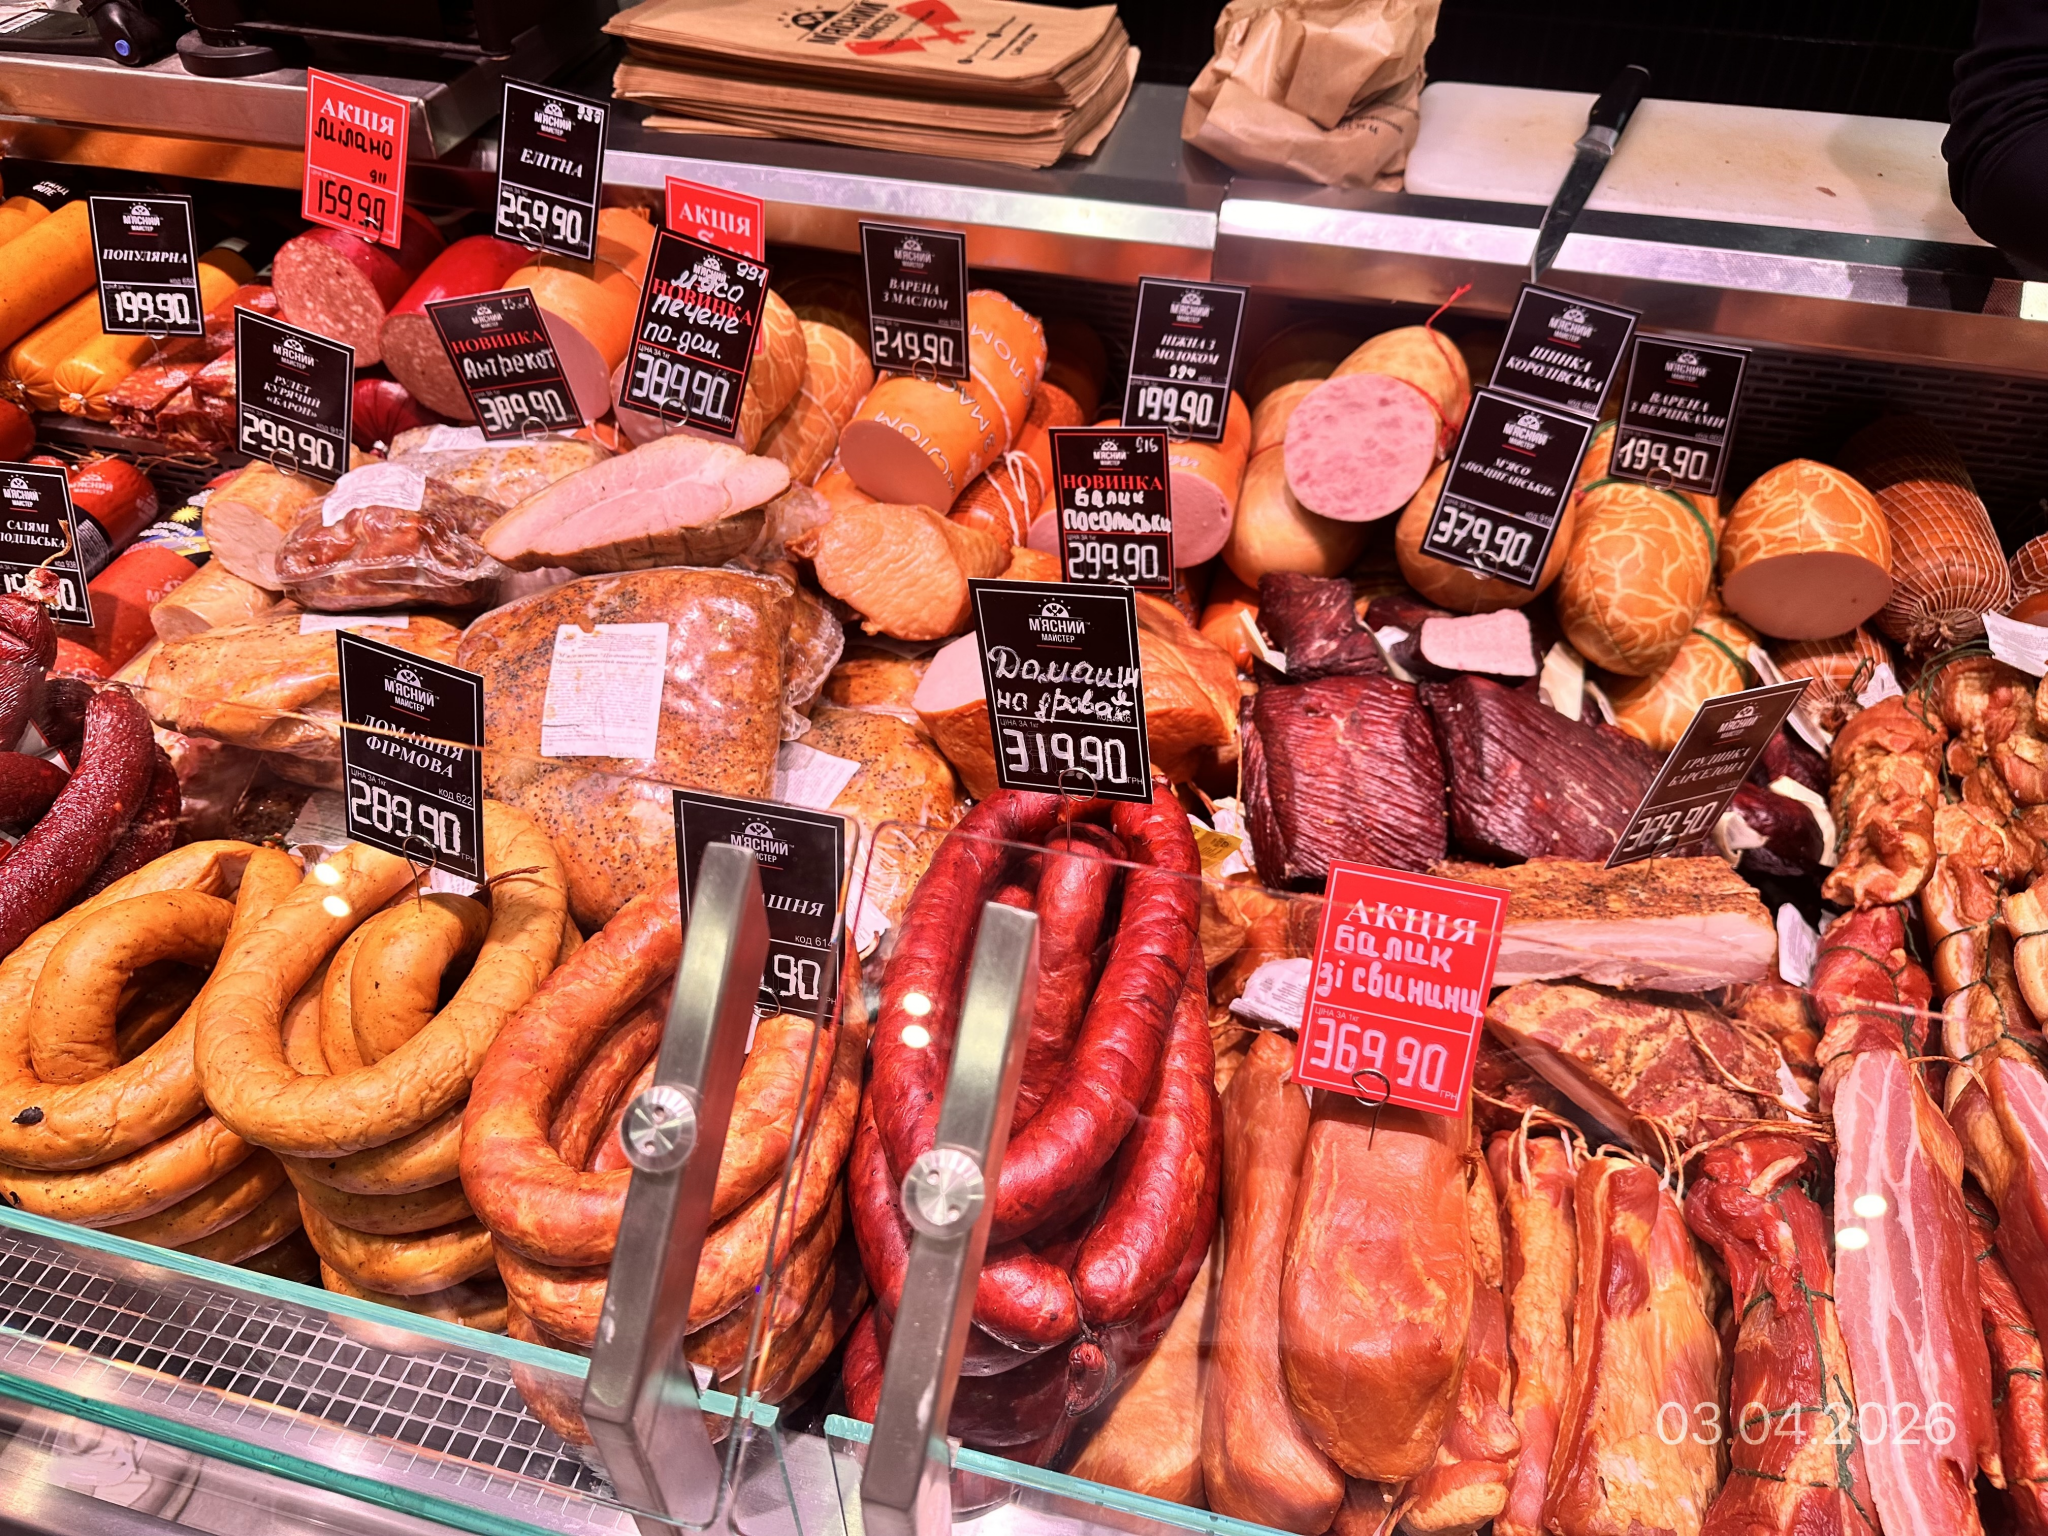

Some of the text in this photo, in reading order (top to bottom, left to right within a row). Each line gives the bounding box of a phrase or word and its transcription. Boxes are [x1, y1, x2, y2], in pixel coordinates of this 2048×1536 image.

[320, 97, 396, 137] АКЦІЯ
[520, 147, 583, 178] ЕЛІТНА
[679, 202, 752, 237] АКЦІЯ
[103, 248, 188, 264] ПОПУЛЯРНА
[736, 261, 768, 288] 991
[889, 277, 940, 295] ВАРЕНА
[891, 292, 949, 310] МАСЛОМ
[451, 330, 545, 354] НОВИНКА
[1160, 333, 1207, 350] НІЖНА
[272, 342, 315, 367] М'ЯСНИЙ
[463, 347, 556, 380] Антрекот
[1152, 347, 1220, 366] МОЛОКОМ
[1529, 344, 1594, 373] ШИНКА
[274, 374, 313, 395] РУЛЕТ
[1505, 355, 1605, 393] КОРОЛІВСЬКА
[263, 381, 321, 408] КУРЯЧИЙ
[1649, 391, 1710, 413] ВАРЕНА
[266, 395, 318, 419] «БАРОН»
[1638, 402, 1726, 429] ВЕРШКАМИ
[1093, 450, 1127, 461] М'ЯСНИЙ
[1493, 457, 1533, 477] М'ЯСО
[1063, 474, 1164, 491] НОВИНКА
[2, 487, 39, 501] М'ЯСНИЙ
[11, 499, 34, 508] МАЙСТЕР
[6, 520, 50, 534] САЛЯМІ
[1028, 617, 1085, 635] М'ЯСНИЙ
[1041, 633, 1075, 644] МАЙСТЕР
[384, 678, 435, 707] М'ЯСНИЙ
[996, 688, 1029, 712] на
[394, 695, 425, 713] МАЙСТЕР
[1000, 718, 1017, 727] ЦІНА
[362, 713, 464, 762] ДОМАШНЯ
[365, 734, 453, 778] ФІРМОВА
[1681, 746, 1751, 771] ГРУДИНКА
[350, 768, 367, 779] ЦІНА
[367, 775, 376, 783] ЗА
[1127, 776, 1143, 785] ГРН
[1667, 761, 1746, 787] БАРСЕЛОНА
[455, 792, 473, 807] 622
[730, 833, 789, 857] М'ЯСНИЙ
[461, 853, 476, 863] ГРН
[1343, 898, 1480, 946] АКЦІЯ
[815, 937, 833, 948] 614
[1352, 960, 1484, 1019] свинини
[1315, 1006, 1334, 1017] ЦІНА
[1335, 1011, 1346, 1020] ЗА
[1439, 1090, 1458, 1100] ГРН
